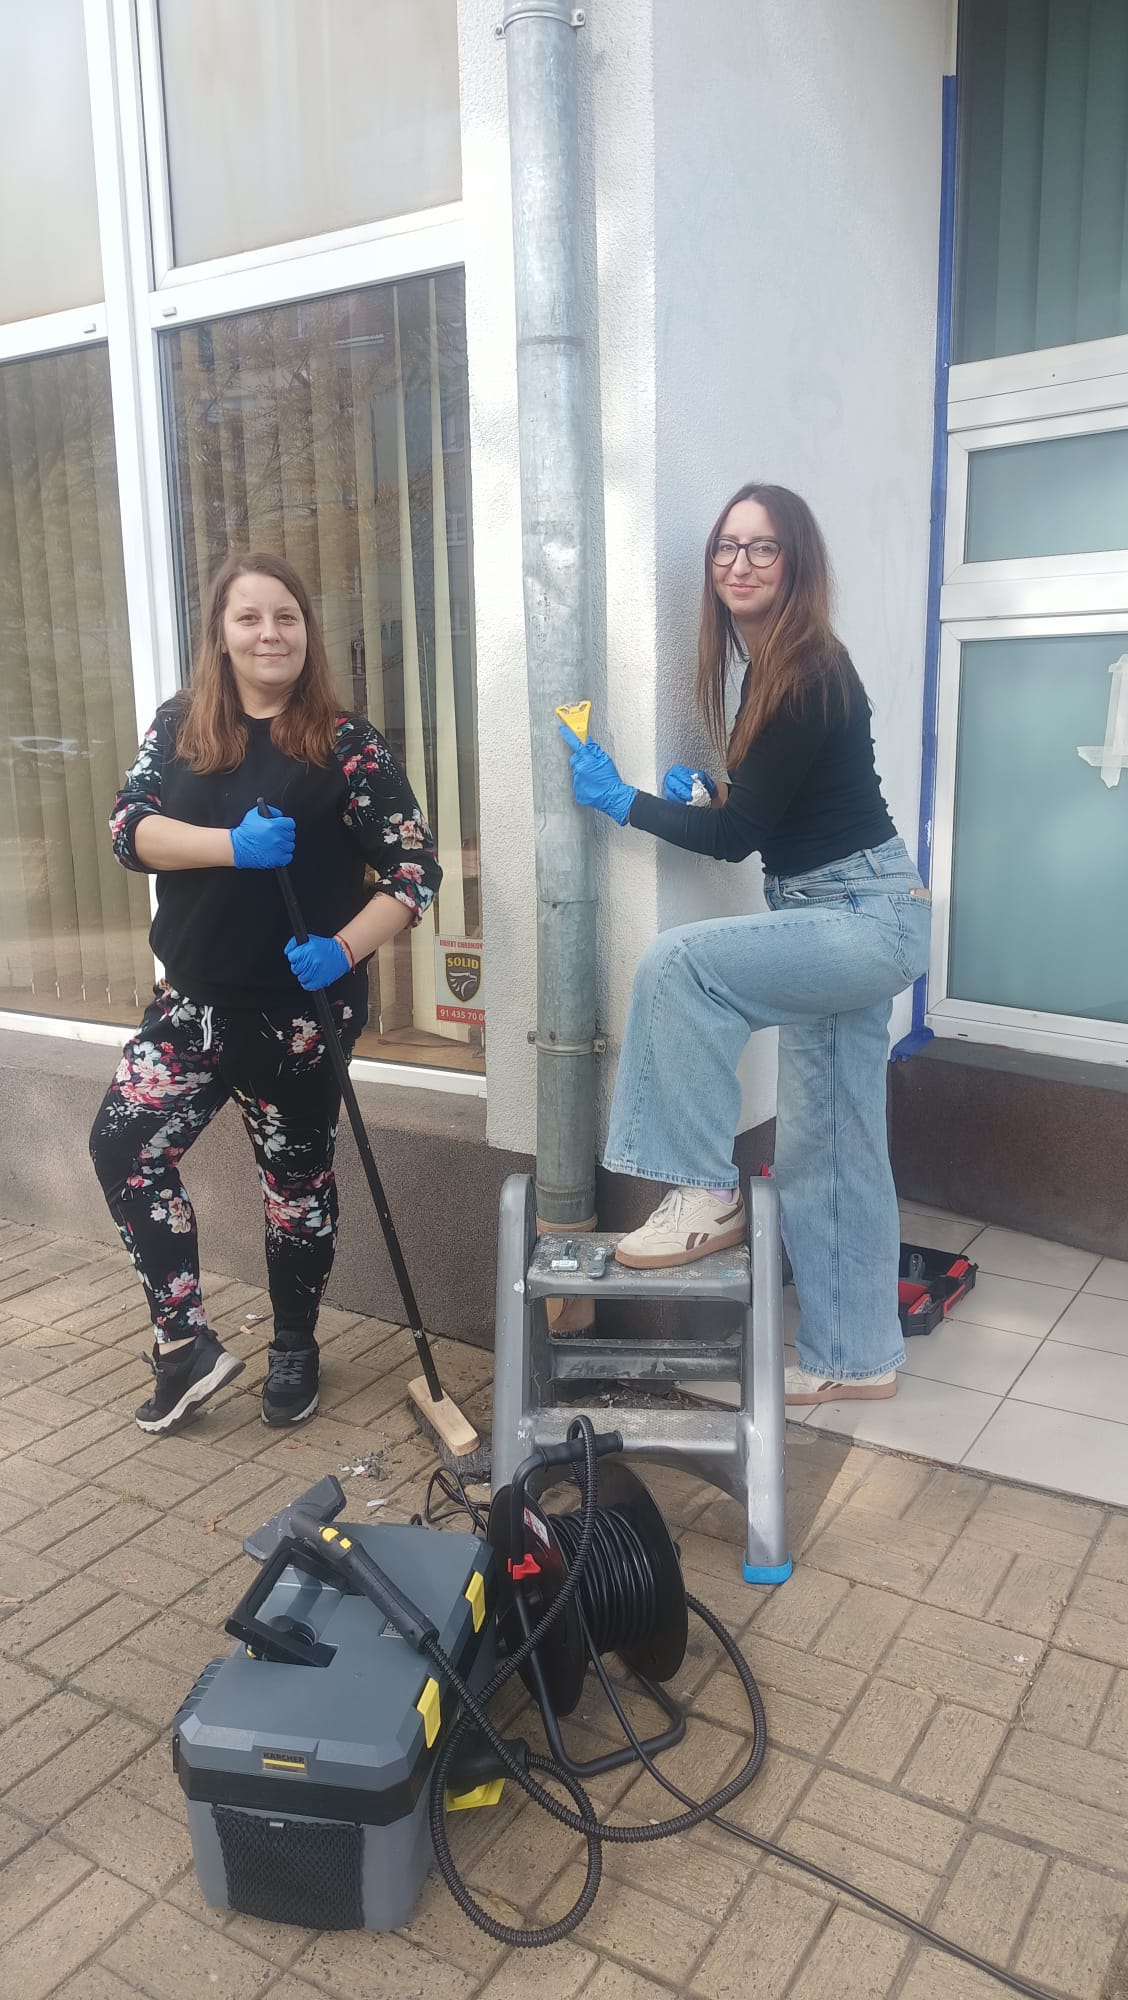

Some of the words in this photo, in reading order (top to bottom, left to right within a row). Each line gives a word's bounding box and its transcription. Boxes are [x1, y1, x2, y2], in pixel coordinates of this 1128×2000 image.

[447, 957, 479, 970] SOLID
[440, 1008, 449, 1017] 91
[451, 1010, 466, 1019] 435
[467, 1012, 477, 1021] 70
